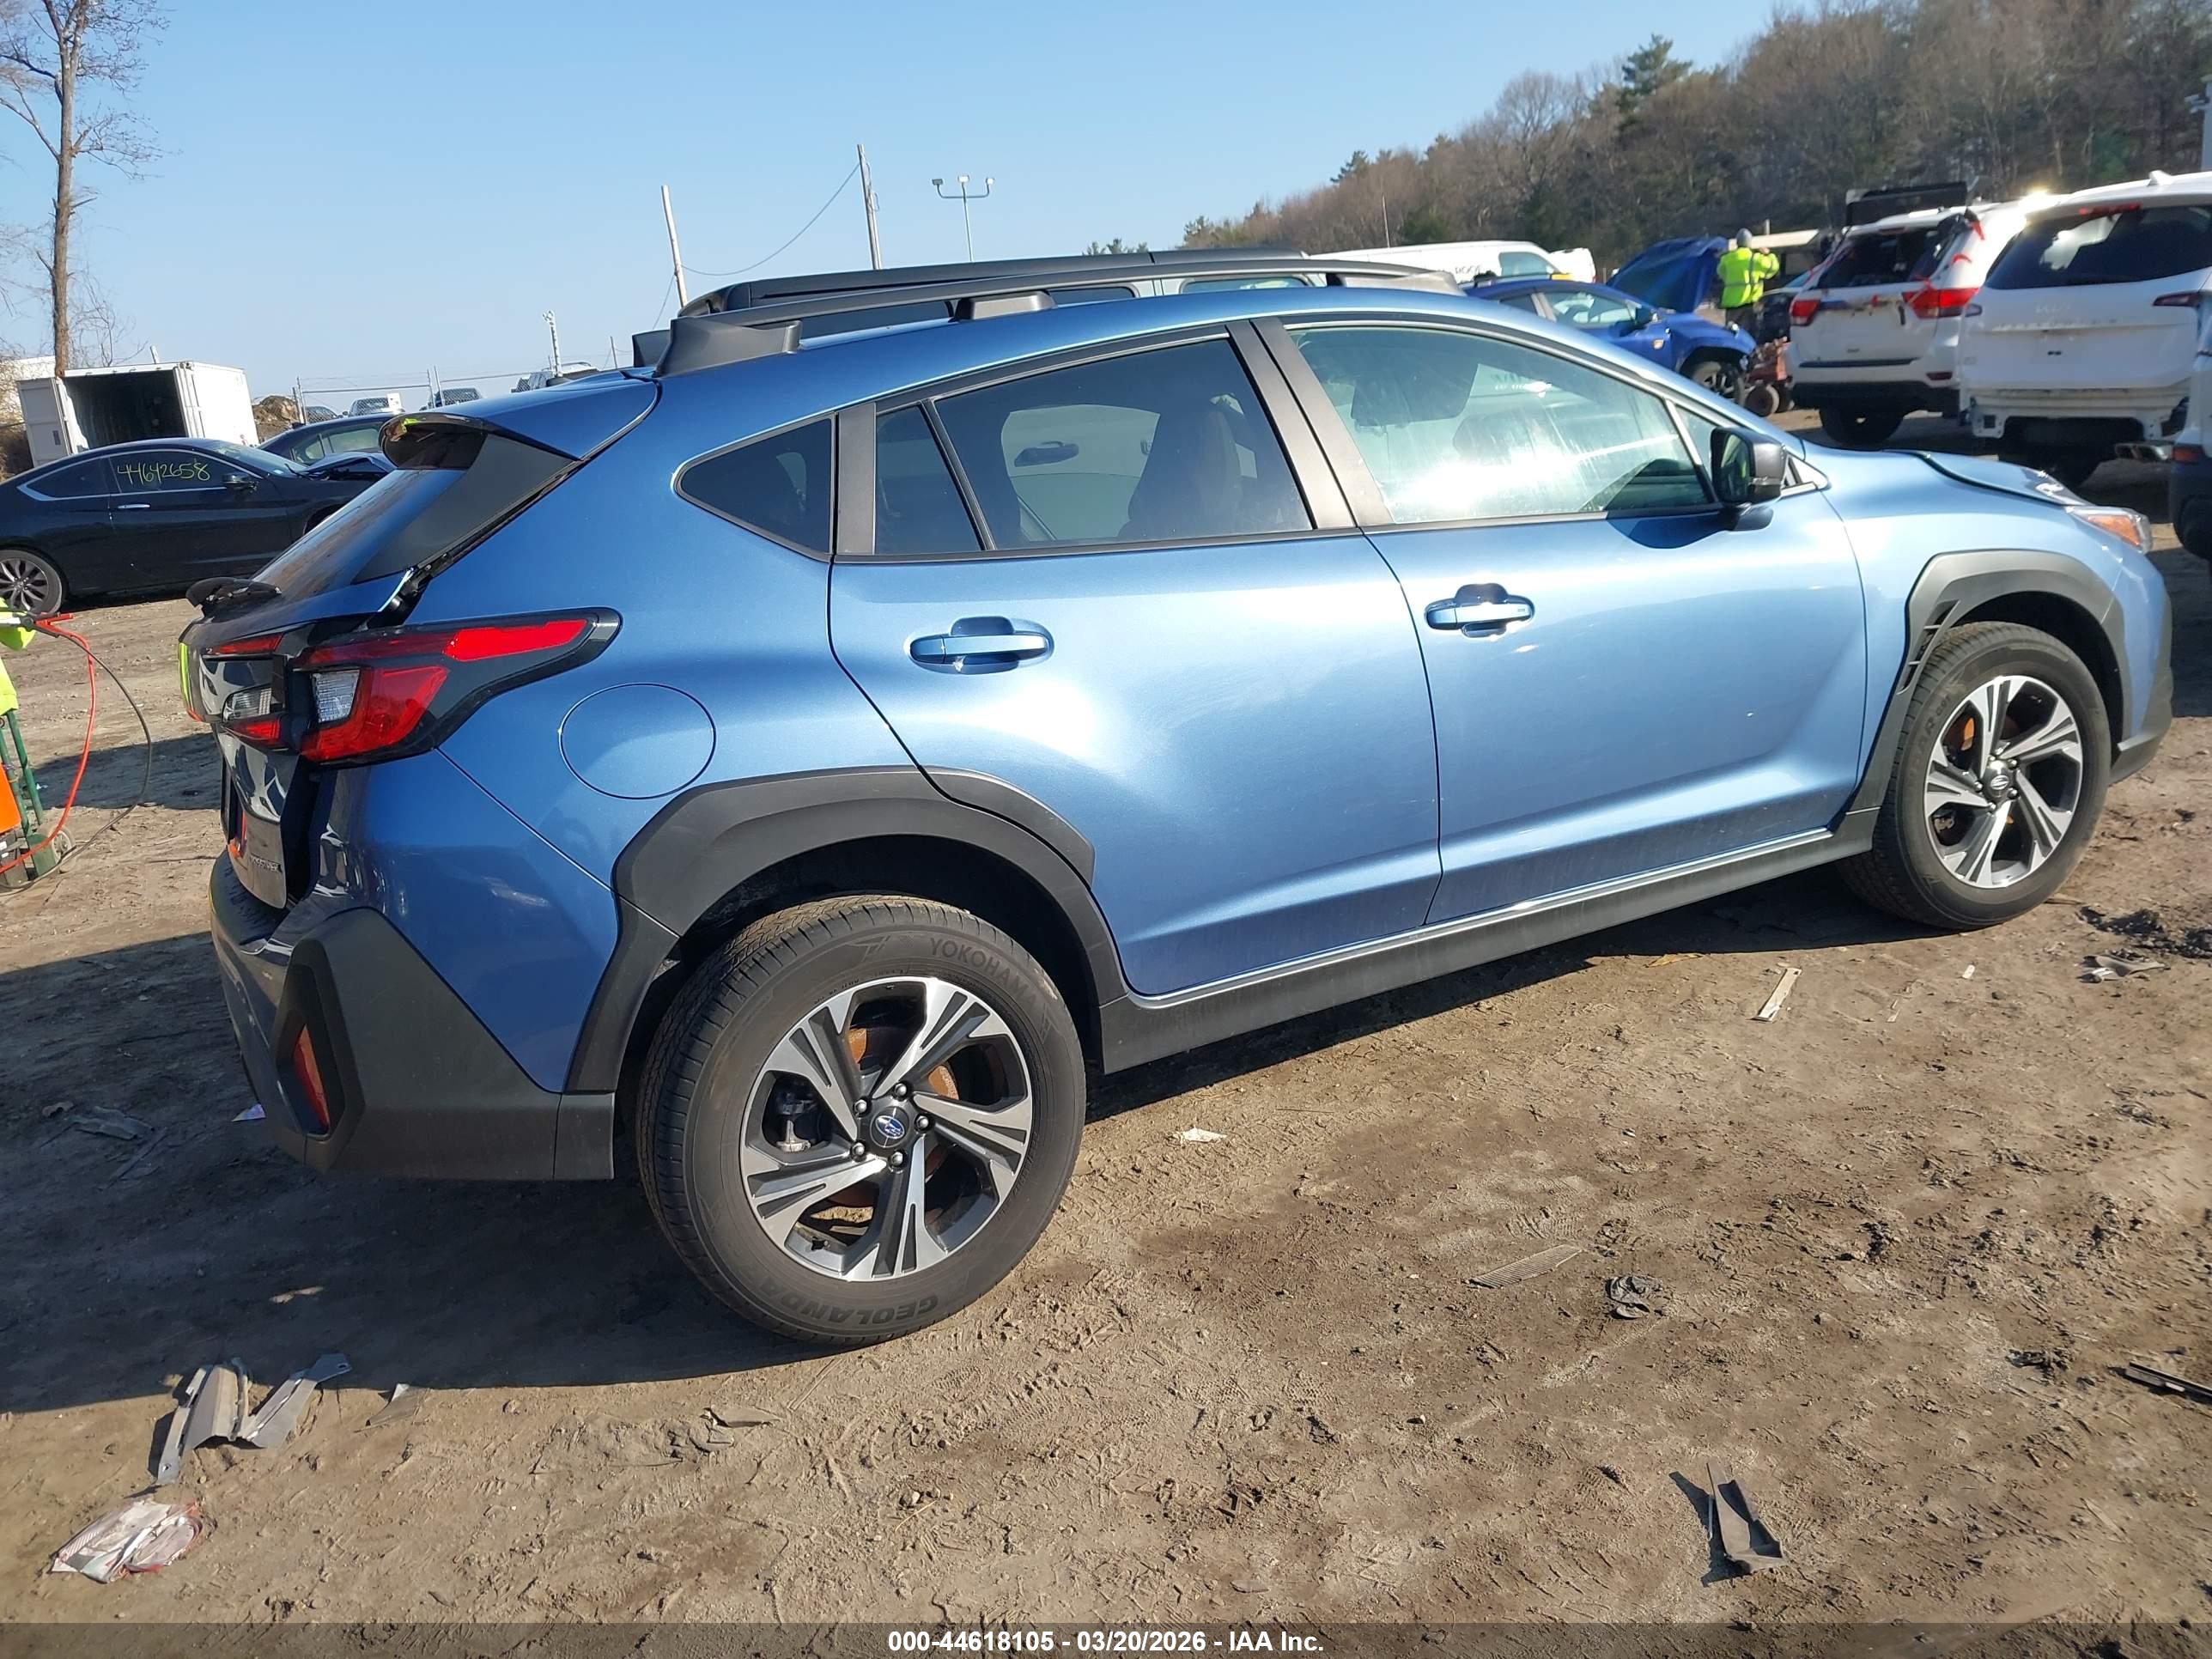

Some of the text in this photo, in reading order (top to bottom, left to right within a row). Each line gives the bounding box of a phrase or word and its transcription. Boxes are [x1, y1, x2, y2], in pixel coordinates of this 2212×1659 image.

[117, 459, 210, 485] 44642658
[930, 937, 1036, 1008] YOKOHAMA
[754, 1273, 939, 1325] GEOLANDA
